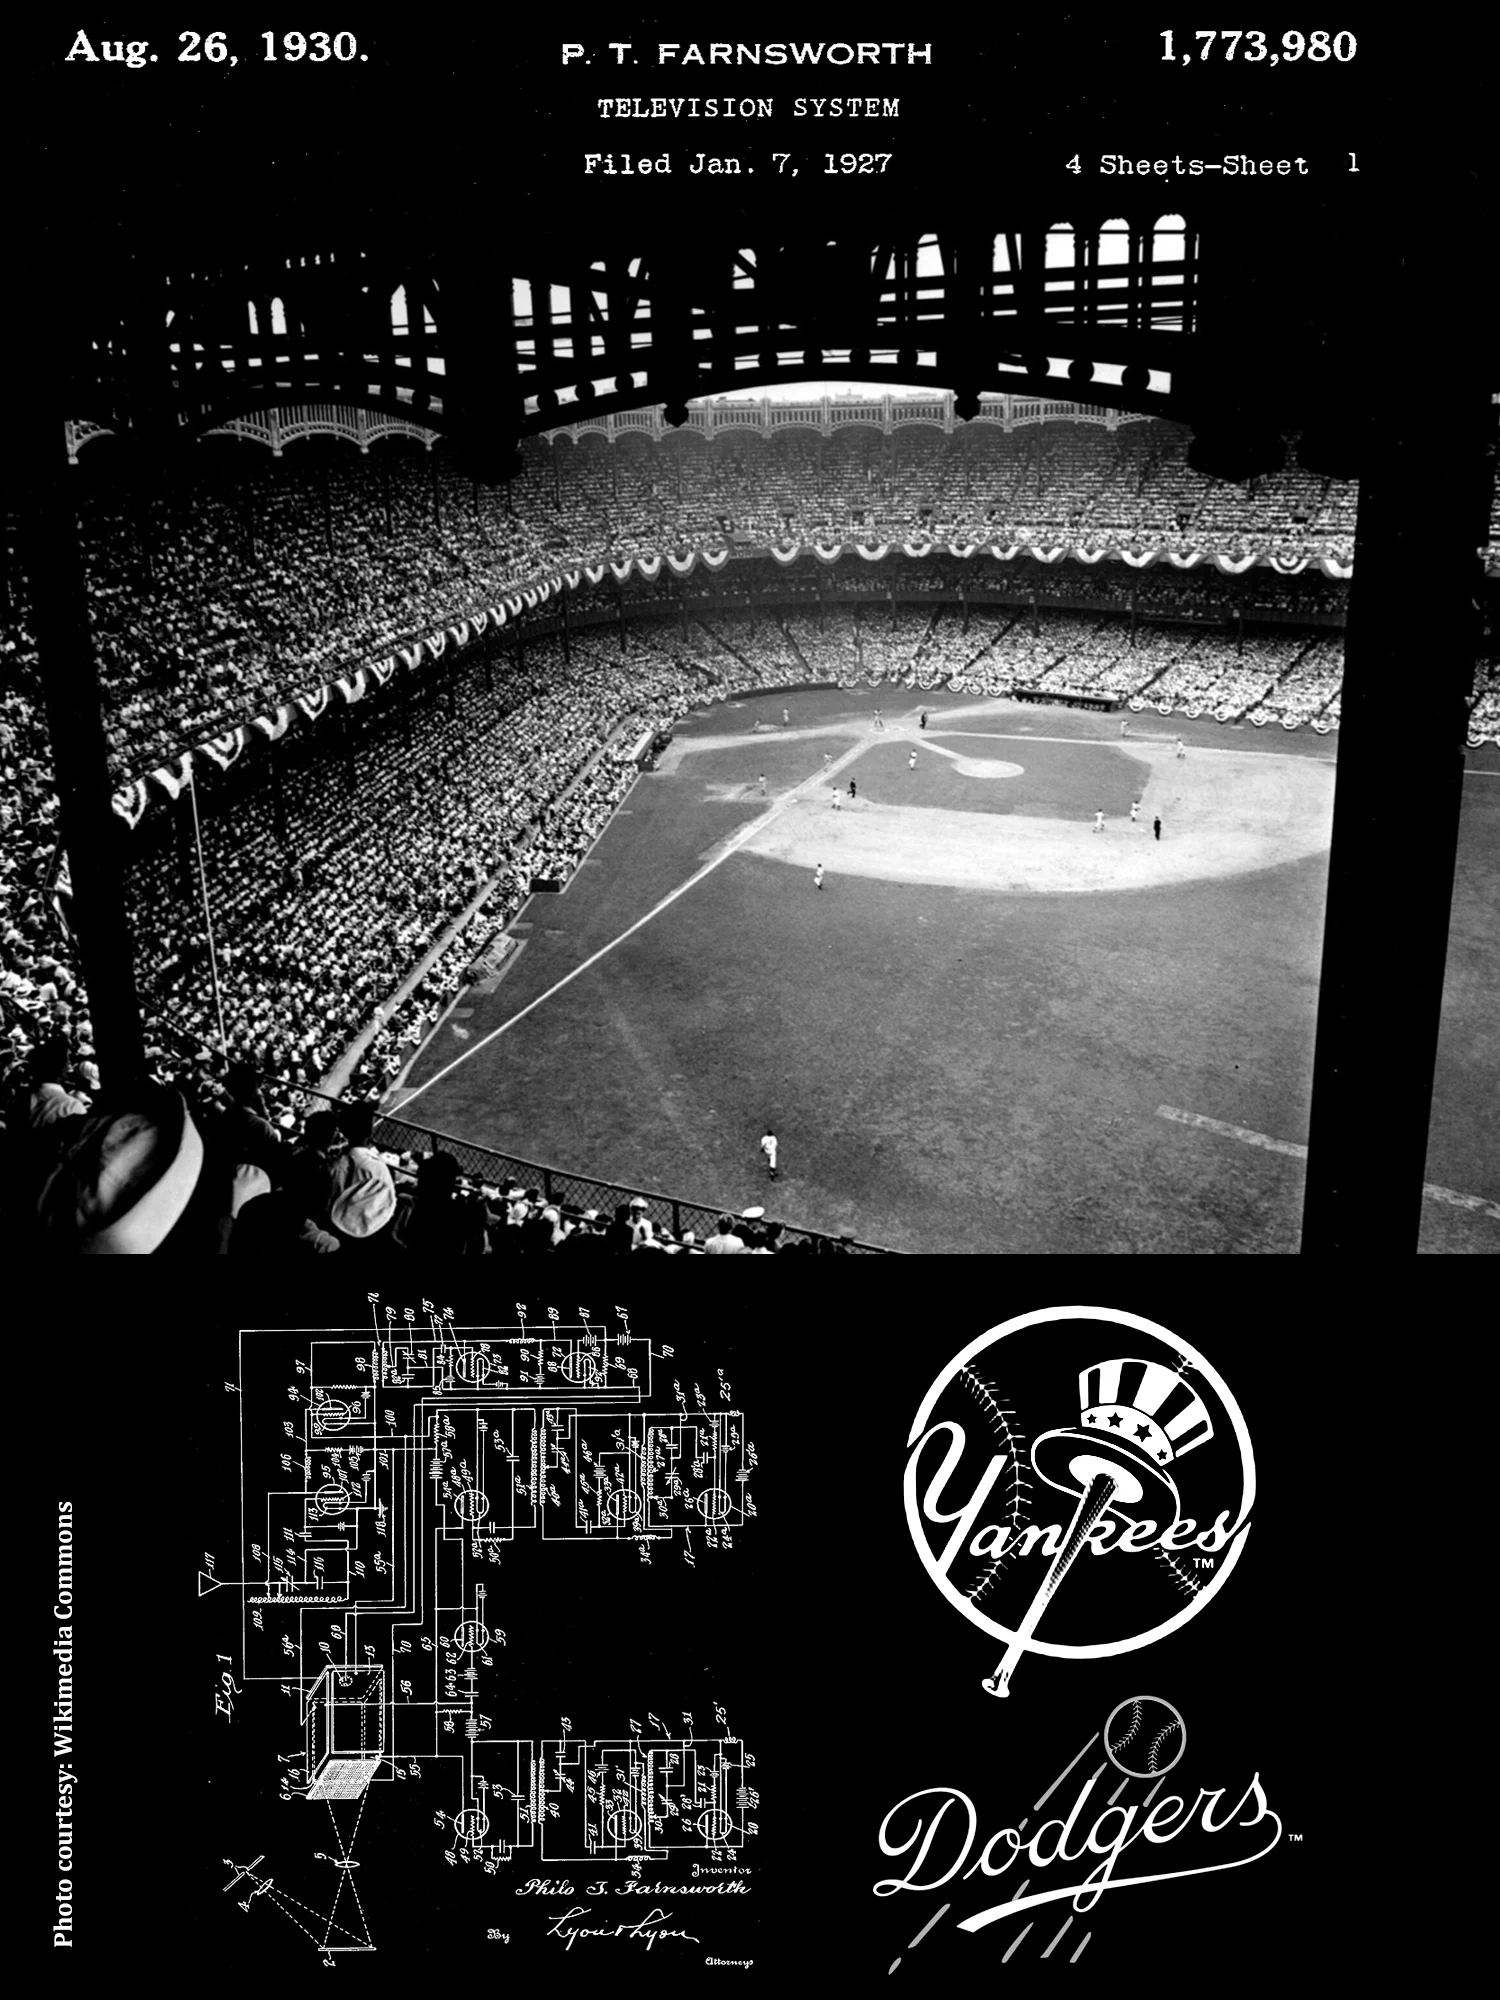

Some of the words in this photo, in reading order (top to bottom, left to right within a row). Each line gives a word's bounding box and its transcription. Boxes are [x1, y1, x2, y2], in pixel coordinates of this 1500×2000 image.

[65, 29, 158, 68] Aug.
[178, 31, 238, 67] 26,
[262, 31, 368, 61] 1930.
[563, 44, 590, 65] P.
[609, 43, 638, 64] T.
[659, 43, 931, 65] FARNSWORTH
[1160, 30, 1357, 67] 1,773,980
[597, 98, 773, 118] TELEVISION
[794, 98, 899, 117] SYSTEM
[584, 154, 671, 174] Filed
[690, 154, 753, 174] Jan.
[773, 154, 798, 177] 7,
[824, 154, 892, 173] 1927
[1066, 154, 1081, 174] 4
[1349, 153, 1360, 172] 1
[422, 1298, 434, 1314] 75
[443, 1307, 454, 1320] 74
[515, 1303, 526, 1319] 92
[547, 1307, 559, 1320] 89
[578, 1307, 590, 1318] 87
[615, 1306, 628, 1320] 67
[385, 1307, 397, 1321] 79
[404, 1309, 415, 1322] 80
[417, 1350, 427, 1360] 81
[519, 1348, 530, 1362] 90
[552, 1346, 562, 1358] 72
[662, 1345, 674, 1357] 70
[295, 1359, 305, 1374] 97
[355, 1357, 366, 1372] 98
[615, 1356, 627, 1370] 69
[519, 1370, 528, 1383] 91
[224, 1381, 235, 1392] 71
[384, 1409, 397, 1428] 100
[283, 1421, 294, 1438] 103
[280, 1453, 292, 1473] 106
[379, 1453, 389, 1470] 101
[321, 1464, 332, 1480] 95
[912, 1421, 1240, 1576] Yankees
[308, 1507, 319, 1522] 113
[283, 1527, 294, 1543] 111
[375, 1522, 387, 1538] 118
[204, 1552, 215, 1570] 117
[251, 1544, 262, 1563] 108
[683, 1550, 695, 1568] 17
[272, 1556, 283, 1573] 115
[313, 1557, 325, 1572] 116
[354, 1560, 365, 1579] 110
[374, 1551, 387, 1574] 55a
[1193, 1558, 1214, 1569] TM
[252, 1611, 264, 1631] 109
[420, 1636, 432, 1651] 65
[439, 1636, 450, 1648] 60
[494, 1628, 506, 1646] 59
[318, 1641, 332, 1654] 10
[363, 1644, 375, 1659] 13
[400, 1640, 411, 1653] 70
[446, 1652, 457, 1665] 62
[482, 1656, 493, 1666] 61
[445, 1668, 457, 1681] 63
[281, 1684, 291, 1697] 11
[399, 1679, 413, 1697] 56
[444, 1682, 457, 1697] 64
[681, 1712, 694, 1726] 31
[712, 1701, 727, 1725] 25'
[443, 1720, 455, 1734] 58
[479, 1714, 493, 1729] 57
[560, 1717, 573, 1732] 43
[629, 1719, 643, 1734] 27
[648, 1712, 661, 1732] 17
[277, 1754, 290, 1762] 7
[744, 1753, 756, 1767] 25
[287, 1769, 301, 1783] 16
[395, 1768, 407, 1780] 15
[408, 1763, 422, 1779] 55
[586, 1770, 597, 1784] 46
[491, 1783, 504, 1800] 53
[697, 1781, 708, 1793] 21
[279, 1793, 292, 1801] 6
[586, 1786, 597, 1804] 45
[548, 1803, 561, 1818] 40
[604, 1799, 614, 1812] 33
[668, 1804, 680, 1817] 29
[433, 1811, 446, 1830] 54
[519, 1807, 530, 1824] 51
[588, 1823, 598, 1837] 41
[654, 1822, 663, 1835] 30
[681, 1818, 692, 1832] 26
[747, 1822, 759, 1835] 20
[873, 1772, 1275, 1914] Dodgers
[1288, 1834, 1304, 1842] TM
[445, 1850, 457, 1866] 48
[460, 1848, 470, 1864] 49
[473, 1850, 483, 1862] 52
[711, 1850, 722, 1861] 22
[726, 1849, 737, 1861] 24
[222, 1859, 233, 1868] 3
[484, 1862, 496, 1875] 50
[691, 1863, 752, 1878] Inventor
[515, 1879, 575, 1896] Philo
[615, 1880, 752, 1896] Farnsworth
[238, 1901, 249, 1912] 4
[487, 1929, 511, 1944] By
[323, 1959, 336, 1967] 2
[705, 1957, 754, 1970] Attorneys
